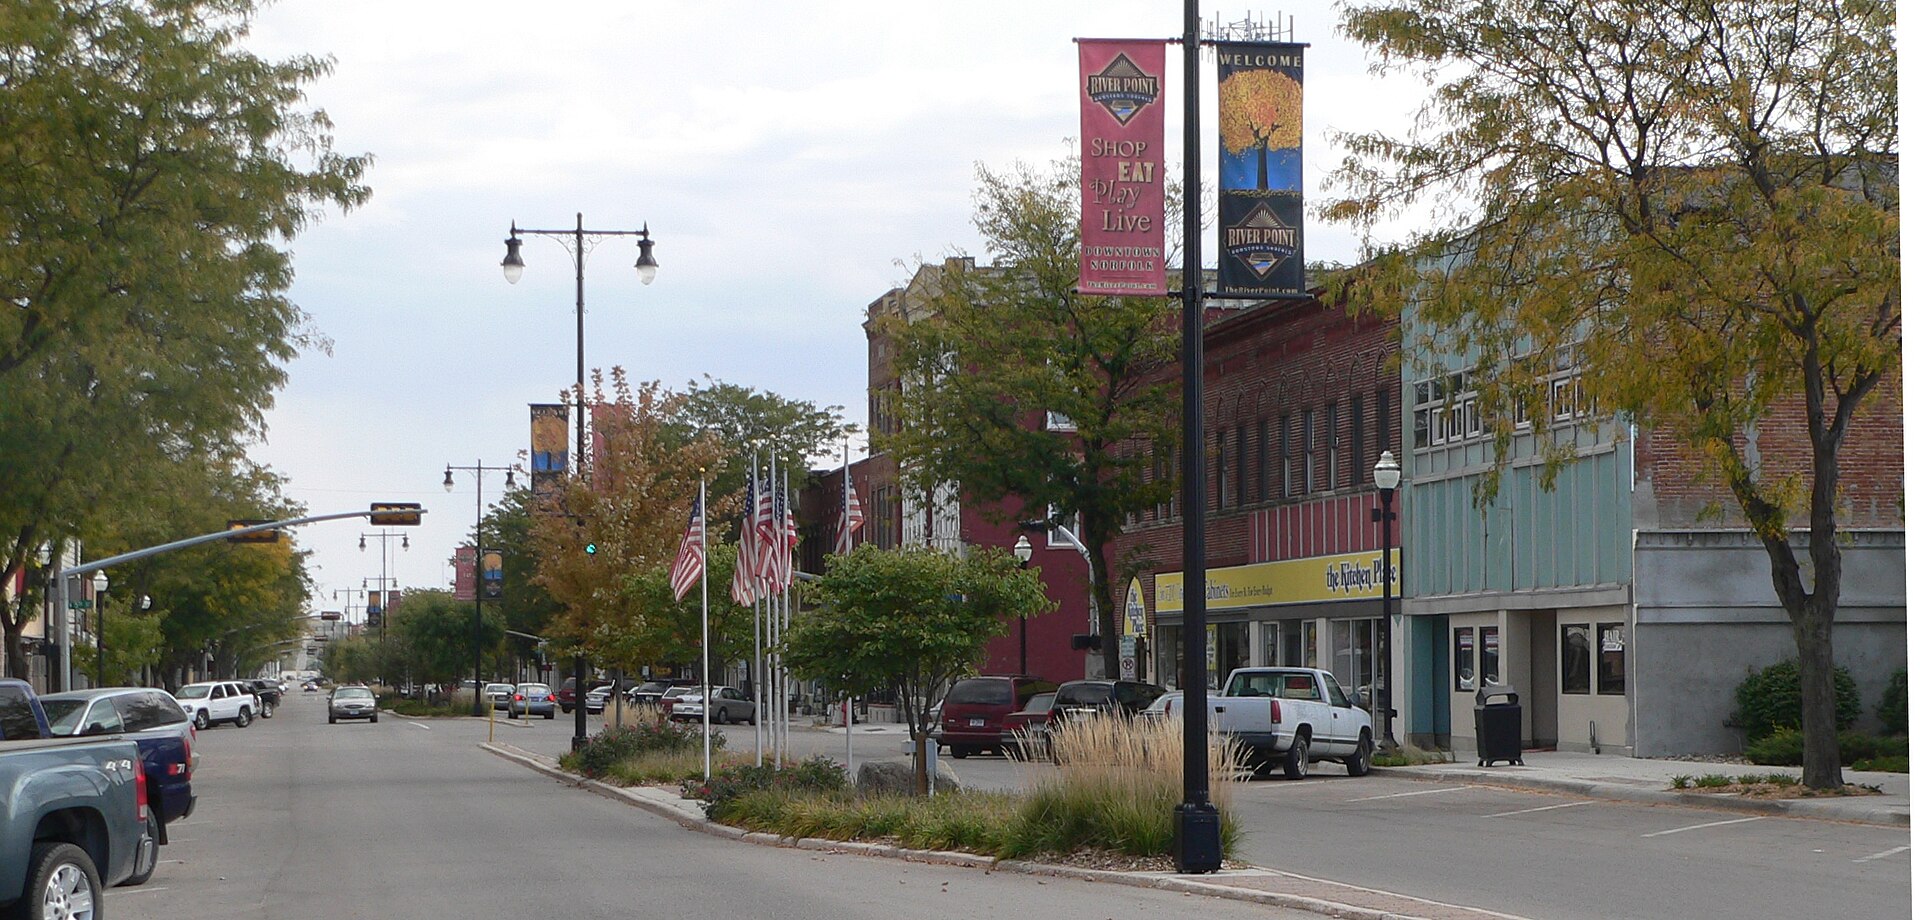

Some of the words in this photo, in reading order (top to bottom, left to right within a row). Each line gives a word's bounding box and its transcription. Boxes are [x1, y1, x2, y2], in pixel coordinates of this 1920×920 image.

[1219, 54, 1302, 68] WELCOME
[1090, 77, 1121, 95] RIVER
[1123, 77, 1155, 96] POINT
[1091, 137, 1147, 158] SHOP
[1118, 161, 1155, 183] EAT
[1088, 178, 1140, 209] Play
[1102, 208, 1151, 232] Live
[1228, 228, 1261, 247] RIVER
[1263, 228, 1296, 248] POINT
[1085, 246, 1160, 257] DOWNTOWN
[1090, 259, 1154, 271] NORFOLK
[1225, 286, 1298, 294] TheRiverPoint.com
[1327, 565, 1339, 592] the
[1341, 561, 1372, 593] Kitchen
[1373, 557, 1397, 583] Ple
[1205, 579, 1229, 600] abinets
[1604, 629, 1620, 642] HAIR
[105, 760, 132, 772] 44
